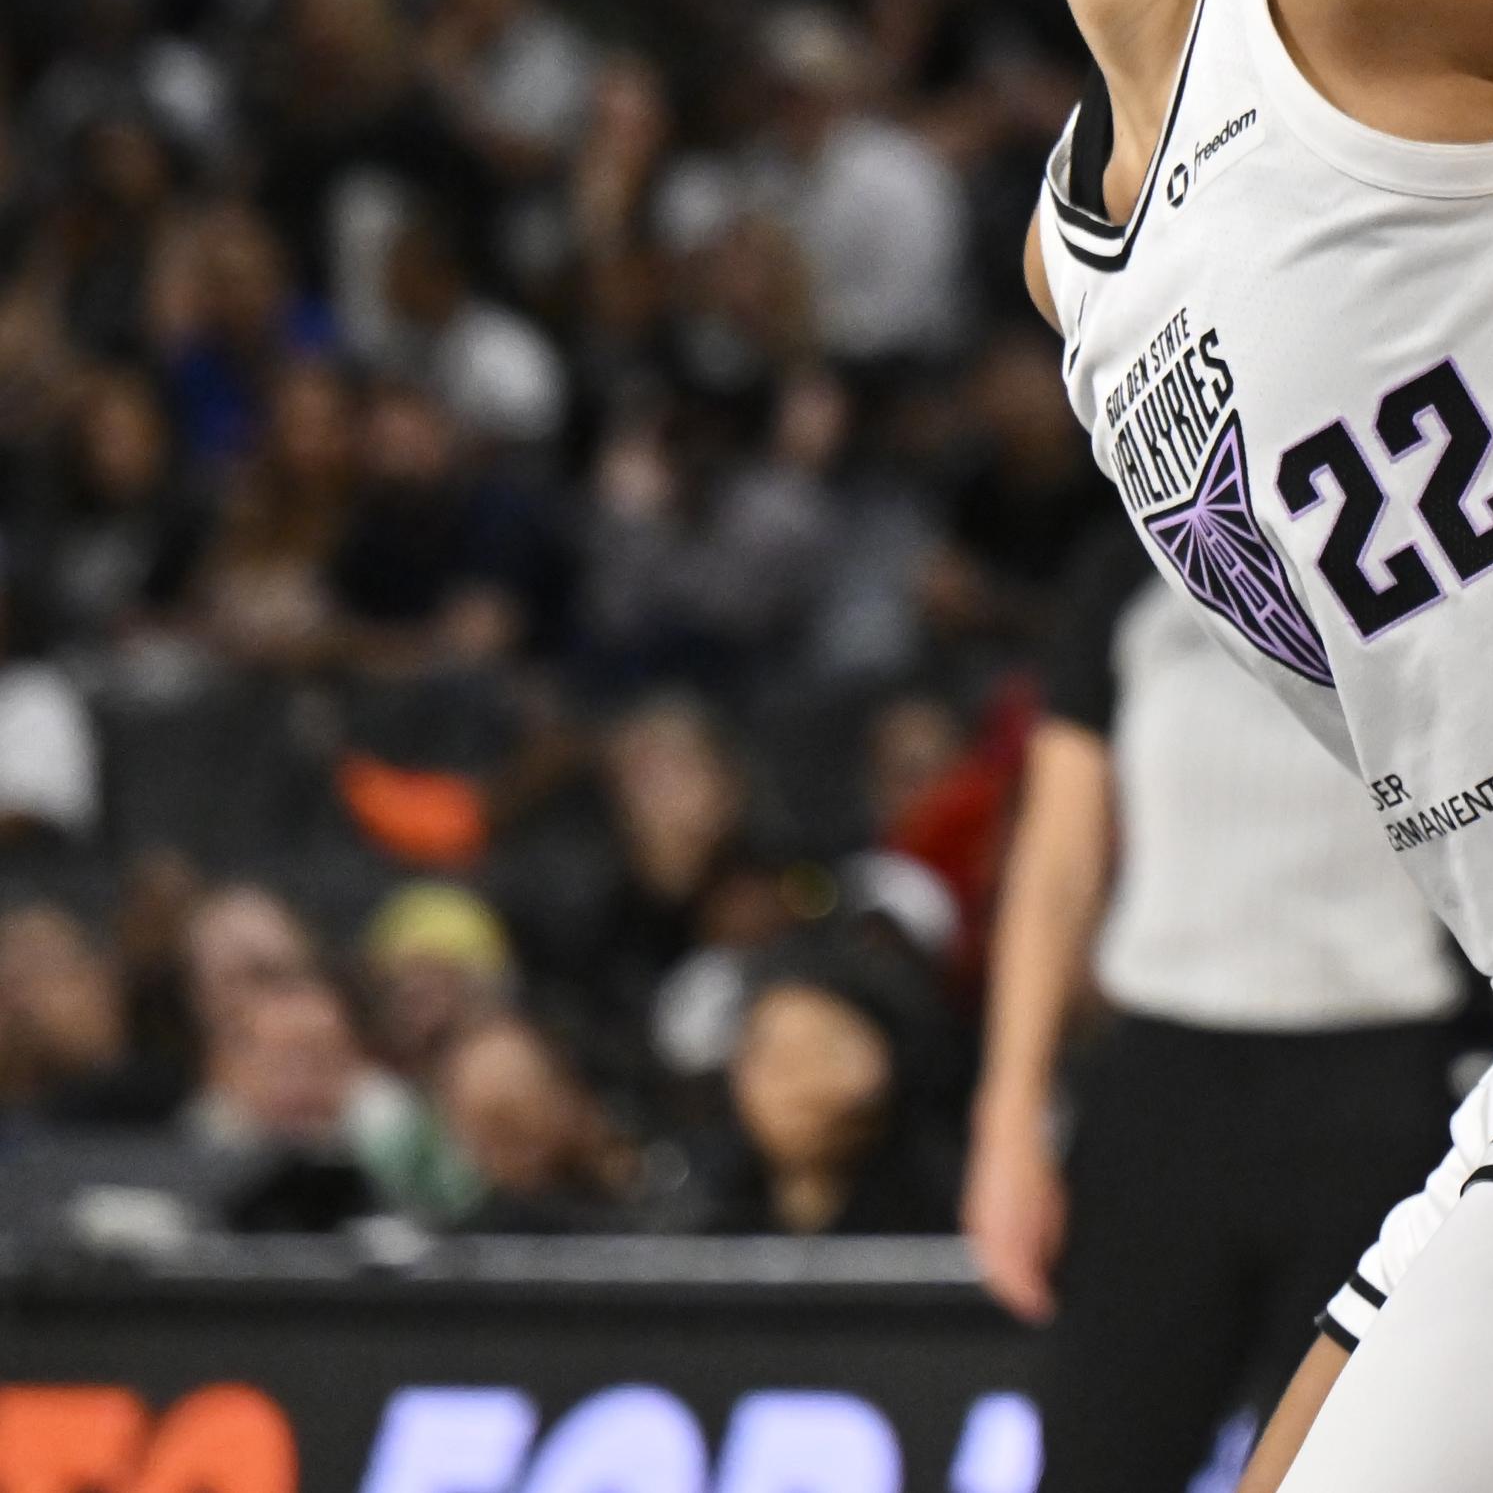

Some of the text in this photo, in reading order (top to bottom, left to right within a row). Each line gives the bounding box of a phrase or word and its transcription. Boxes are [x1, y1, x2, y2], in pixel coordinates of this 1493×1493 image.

[1193, 108, 1256, 184] freedom
[1106, 307, 1190, 429] GOLDEN STATE
[1111, 327, 1234, 513] VALKYRIES
